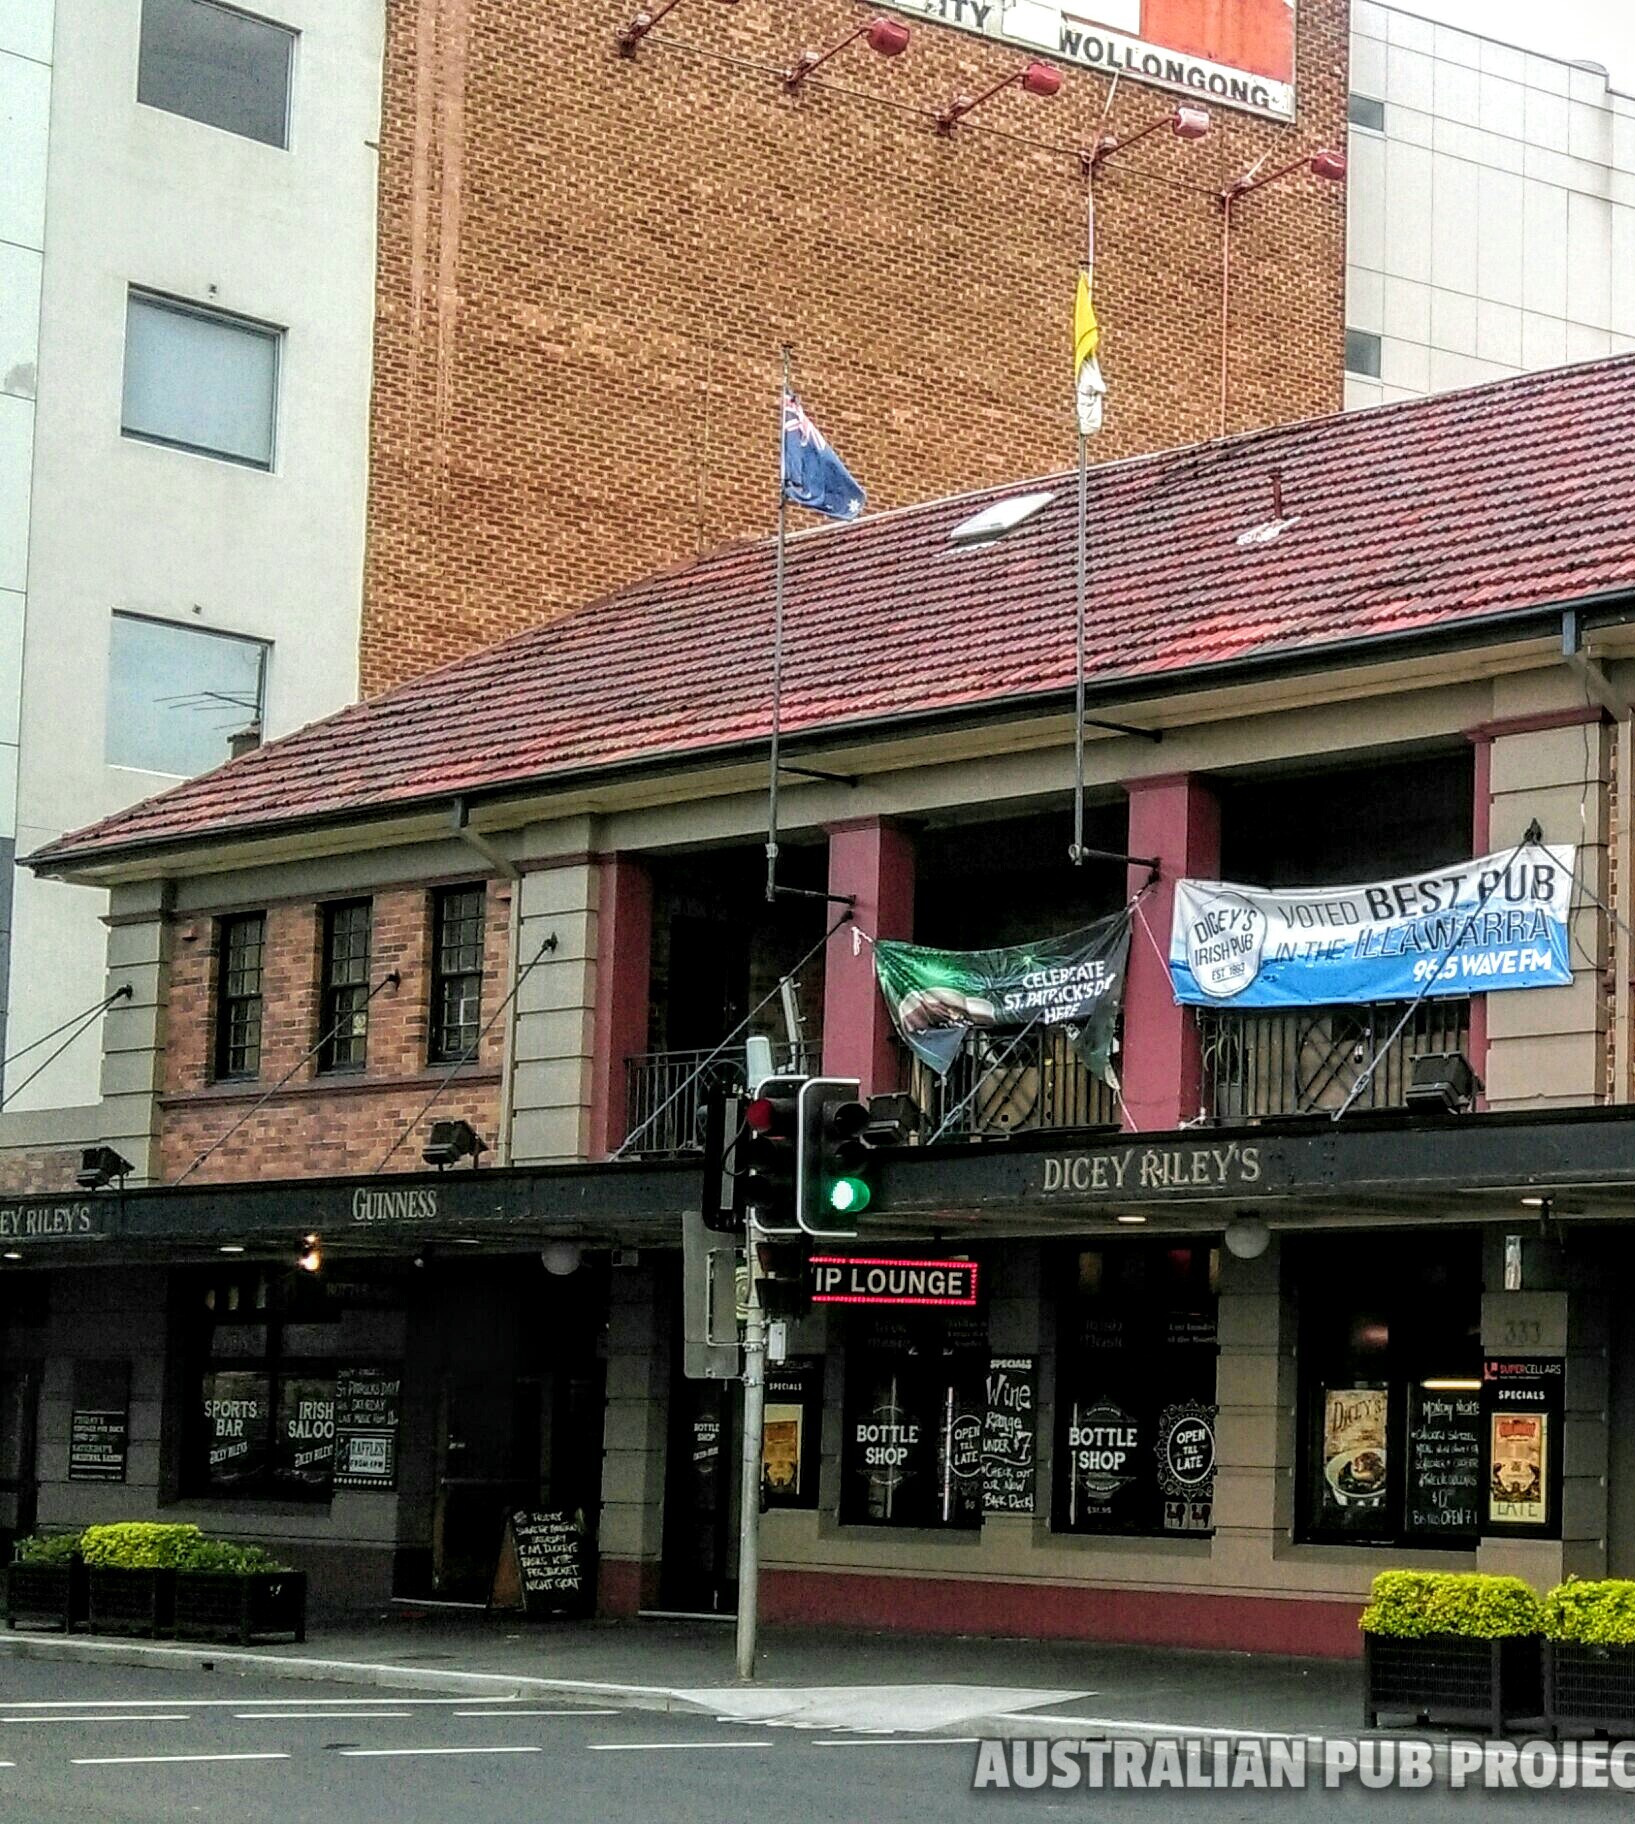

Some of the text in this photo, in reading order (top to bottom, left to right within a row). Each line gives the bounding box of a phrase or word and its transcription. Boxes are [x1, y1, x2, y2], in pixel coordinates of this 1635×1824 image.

[927, 0, 991, 27] ITY
[1060, 26, 1271, 110] WOLLONGONG
[1278, 864, 1556, 929] VOTED BEST PUB
[1194, 908, 1257, 944] DICEY'S
[1275, 907, 1552, 963] IN THE ILLAWARRA
[1194, 933, 1254, 967] IRISH PUB
[1211, 968, 1225, 981] EST
[1412, 947, 1552, 983] 96.5 WAVE FM
[1095, 973, 1116, 997] DY
[1043, 1142, 1262, 1192] DICEY RILEY'S
[352, 1187, 437, 1221] GUINNESS
[26, 1203, 91, 1236] RILEY'S
[811, 1267, 963, 1295] IP LOUNGE
[990, 1359, 1032, 1369] SPECIALS
[769, 1382, 803, 1391] SPECIALS
[985, 1374, 1032, 1412] Wine
[1498, 1389, 1546, 1400] SPECIALS
[204, 1401, 258, 1419] SPORTS
[298, 1401, 335, 1420] IRISH
[215, 1420, 243, 1437] BAR
[287, 1420, 335, 1439] SALOO
[693, 1422, 720, 1432] BOTTLE
[856, 1424, 919, 1444] BOTTLE
[954, 1425, 980, 1441] OPEN
[1069, 1426, 1138, 1448] BOTTLE
[1176, 1427, 1206, 1446] OPEN
[865, 1447, 908, 1465] SHOP
[983, 1438, 1012, 1454] UNDER
[954, 1451, 980, 1466] LATE
[1078, 1450, 1127, 1471] SHOP
[1176, 1455, 1204, 1472] LATE
